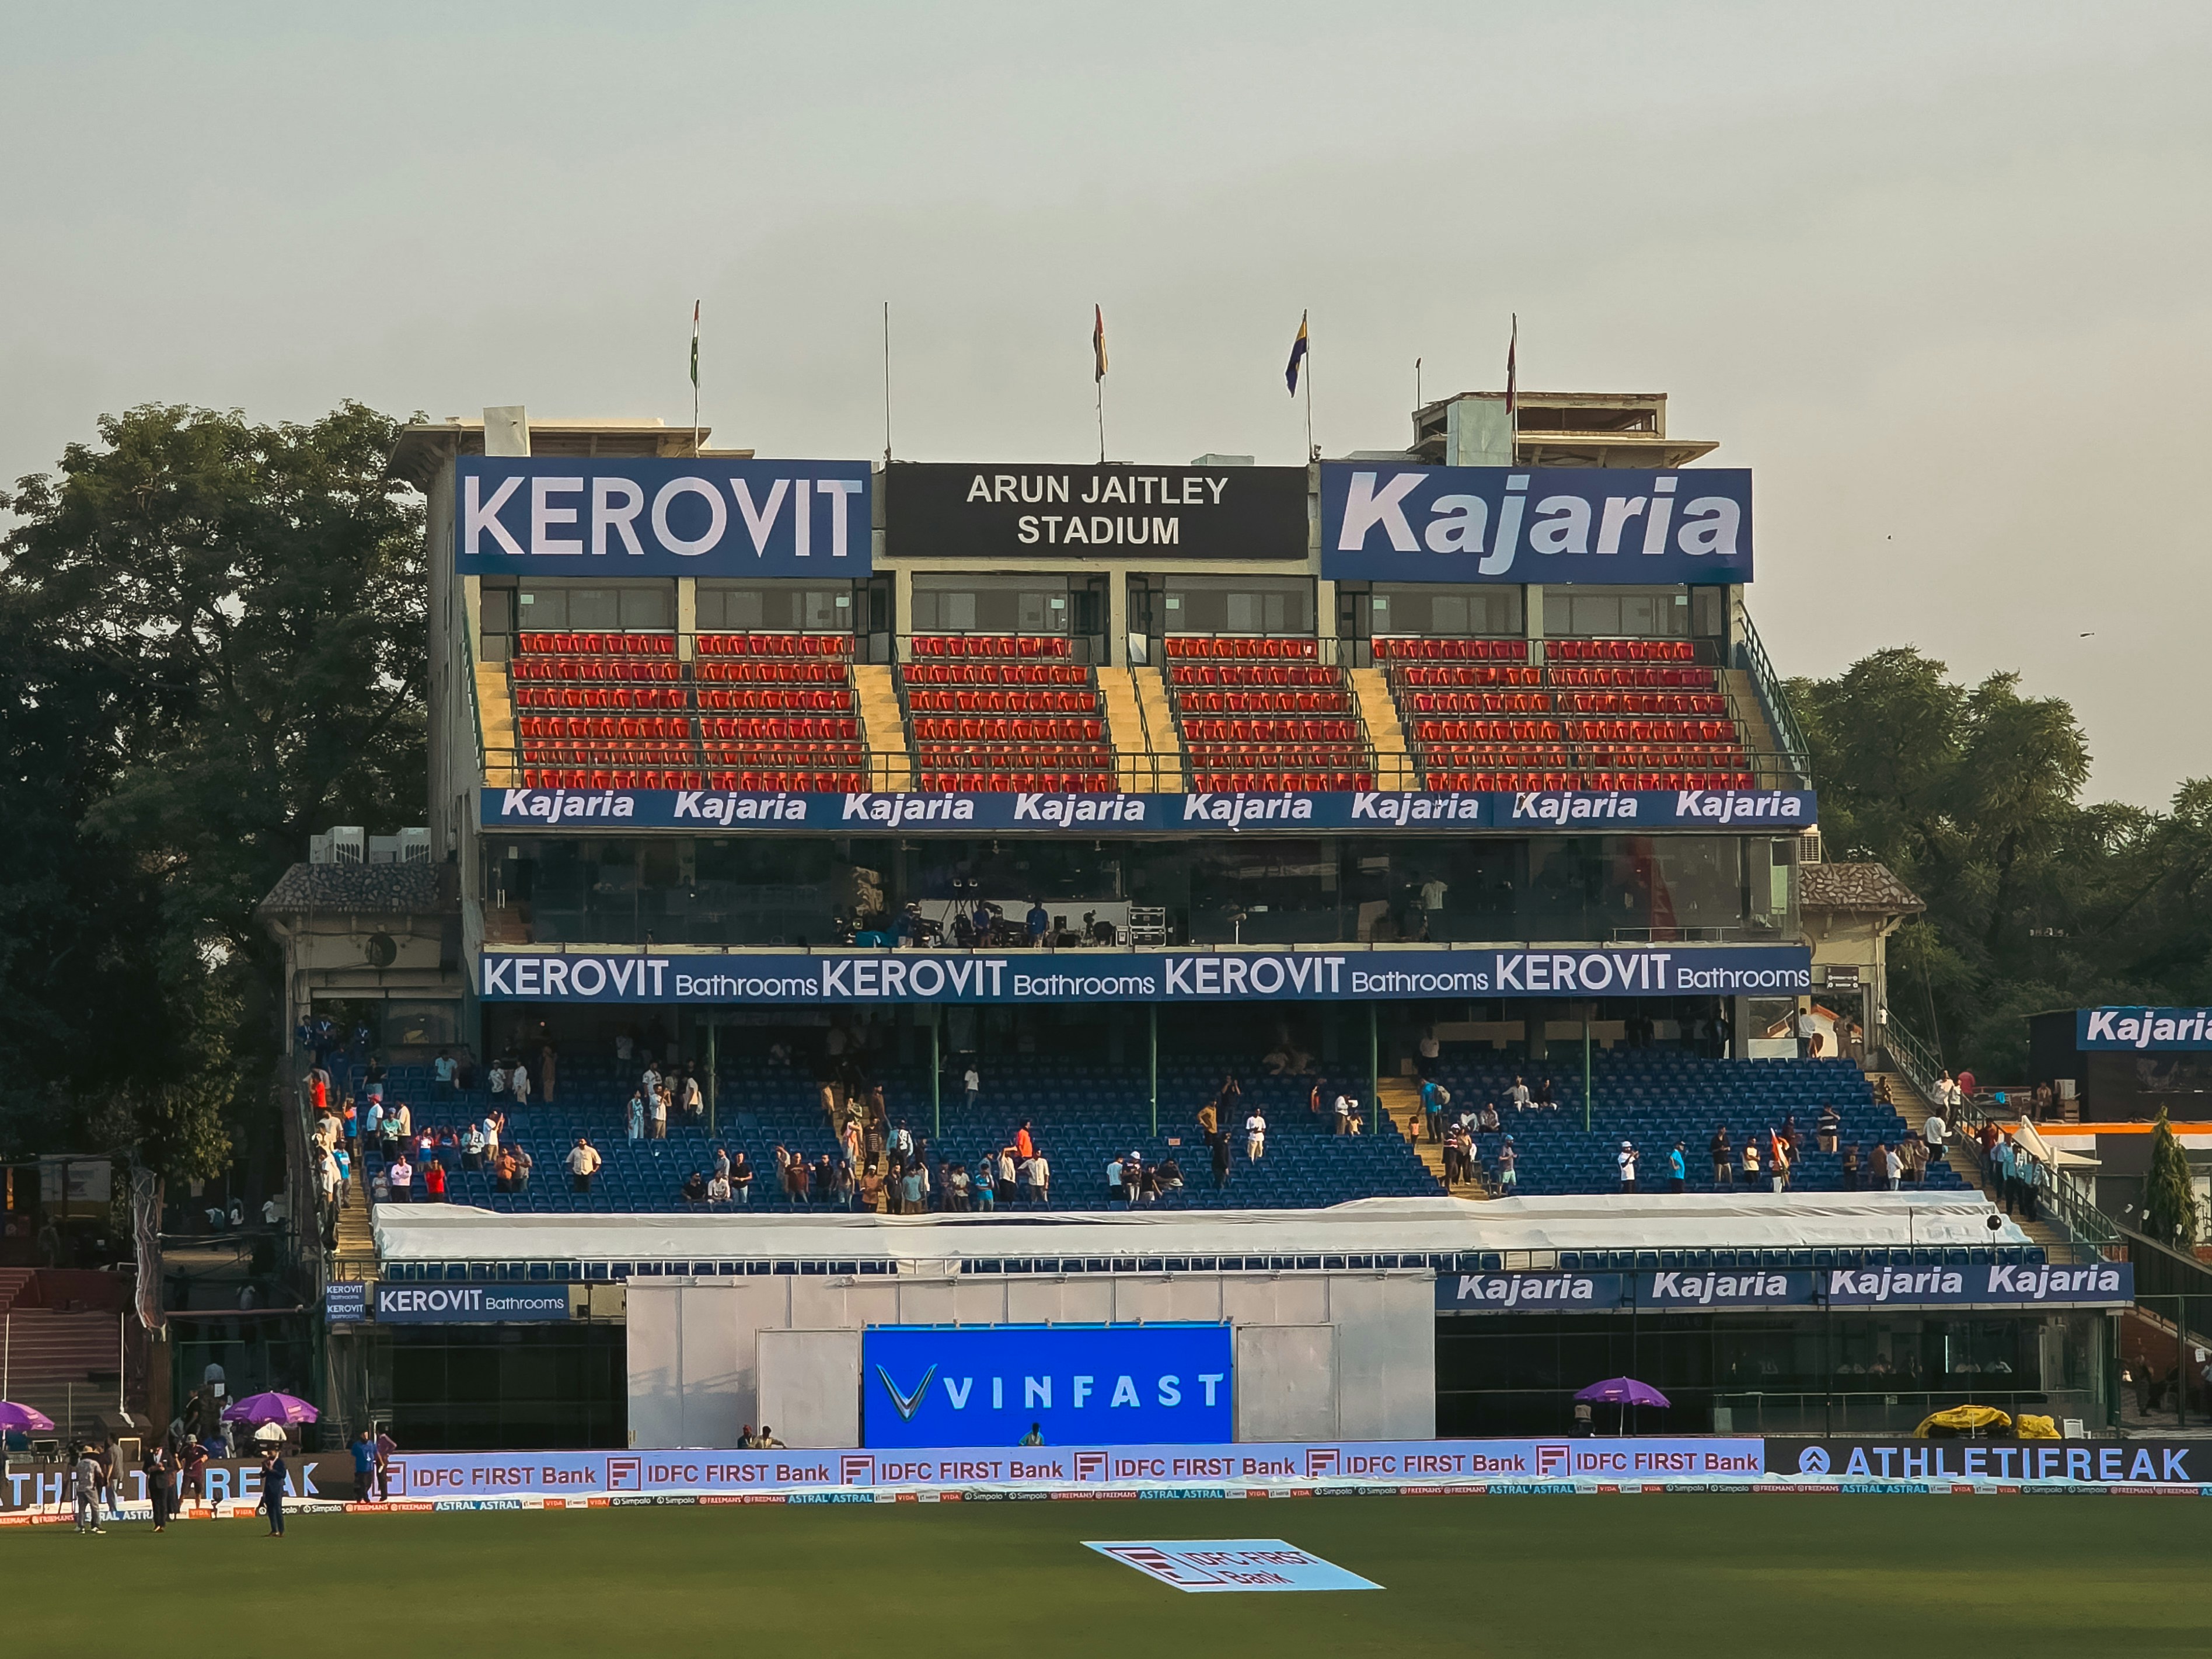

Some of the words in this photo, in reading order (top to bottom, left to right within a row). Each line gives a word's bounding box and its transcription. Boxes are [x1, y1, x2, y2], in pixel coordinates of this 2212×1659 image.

[967, 475, 1069, 503] ARUN
[1081, 476, 1229, 505] JAITLEY
[464, 476, 863, 558] KEROVIT
[1337, 471, 1741, 575] Kajaria
[1017, 515, 1180, 545] STADIUM
[501, 789, 634, 823] Kajaria
[674, 791, 806, 826] Kajaria
[842, 793, 974, 827] Kajaria
[1014, 793, 1146, 827] Kajaria
[1183, 792, 1313, 827] Kajaria
[1351, 792, 1479, 826] Kajaria
[1512, 791, 1638, 825] Kajaria
[1676, 790, 1802, 824] Kajaria
[484, 958, 669, 997] KEROVIT
[676, 974, 818, 997] Bathrooms
[822, 959, 1007, 997] KEROVIT
[1014, 974, 1155, 996] Bathrooms
[1165, 957, 1345, 994] KEROVIT
[1352, 971, 1489, 993] Bathrooms
[1496, 954, 1672, 991] KEROVIT
[1678, 967, 1810, 989] Bathrooms
[327, 1285, 363, 1294] KEROVIT
[1457, 1273, 1594, 1307] Kajaria
[1652, 1271, 1787, 1304] Kajaria
[1830, 1267, 1962, 1301] Kajaria
[1987, 1264, 2120, 1299] Kajaria
[327, 1304, 364, 1313] KEROVIT
[381, 1289, 483, 1313] KEROVIT
[486, 1297, 564, 1310] Bathrooms
[943, 1372, 1224, 1409] VINFAST
[648, 1465, 699, 1482] IDFC
[706, 1464, 769, 1482] FIRST
[776, 1463, 829, 1481] Bank
[881, 1462, 932, 1480] IDFC
[940, 1461, 1002, 1479] FIRST
[1010, 1460, 1063, 1479] Bank
[1115, 1459, 1165, 1476] IDFC
[1173, 1458, 1235, 1476] FIRST
[1243, 1457, 1295, 1475] Bank
[1347, 1455, 1397, 1473] IDFC
[1404, 1454, 1466, 1472] FIRST
[1473, 1453, 1526, 1471] Bank
[1576, 1452, 1627, 1471] IDFC
[1635, 1452, 1697, 1470] FIRST
[1705, 1452, 1759, 1471] Bank
[1845, 1447, 2190, 1480] ATHLETIFREAK
[413, 1468, 464, 1487] IDFC
[472, 1466, 535, 1486] FIRST
[542, 1465, 597, 1484] Bank
[788, 1494, 828, 1503] ASTRAL
[832, 1494, 873, 1503] ASTRAL
[974, 1492, 1003, 1500] Simpolo
[1017, 1492, 1047, 1500] Simpolo
[1140, 1490, 1179, 1499] ASTRAL
[1182, 1489, 1223, 1499] ASTRAL
[1323, 1487, 1353, 1496] Simpolo
[1366, 1487, 1397, 1496] Simpolo
[1489, 1485, 1529, 1494] ASTRAL
[1533, 1485, 1573, 1494] ASTRAL
[1674, 1485, 1704, 1493] Simpolo
[1719, 1484, 1749, 1493] Simpolo
[1842, 1484, 1882, 1493] ASTRAL
[1886, 1484, 1927, 1493] ASTRAL
[2031, 1486, 2062, 1494] Simpolo
[2077, 1486, 2107, 1494] Simpolo
[312, 1504, 342, 1513] Simpolo
[436, 1501, 476, 1511] ASTRAL
[480, 1500, 518, 1510] ASTRAL
[665, 1497, 695, 1506] Simpolo
[122, 1510, 153, 1520] ASTR
[1177, 1552, 1250, 1566] IDFC
[1236, 1550, 1318, 1565] FIRST
[1217, 1570, 1295, 1584] Bank
